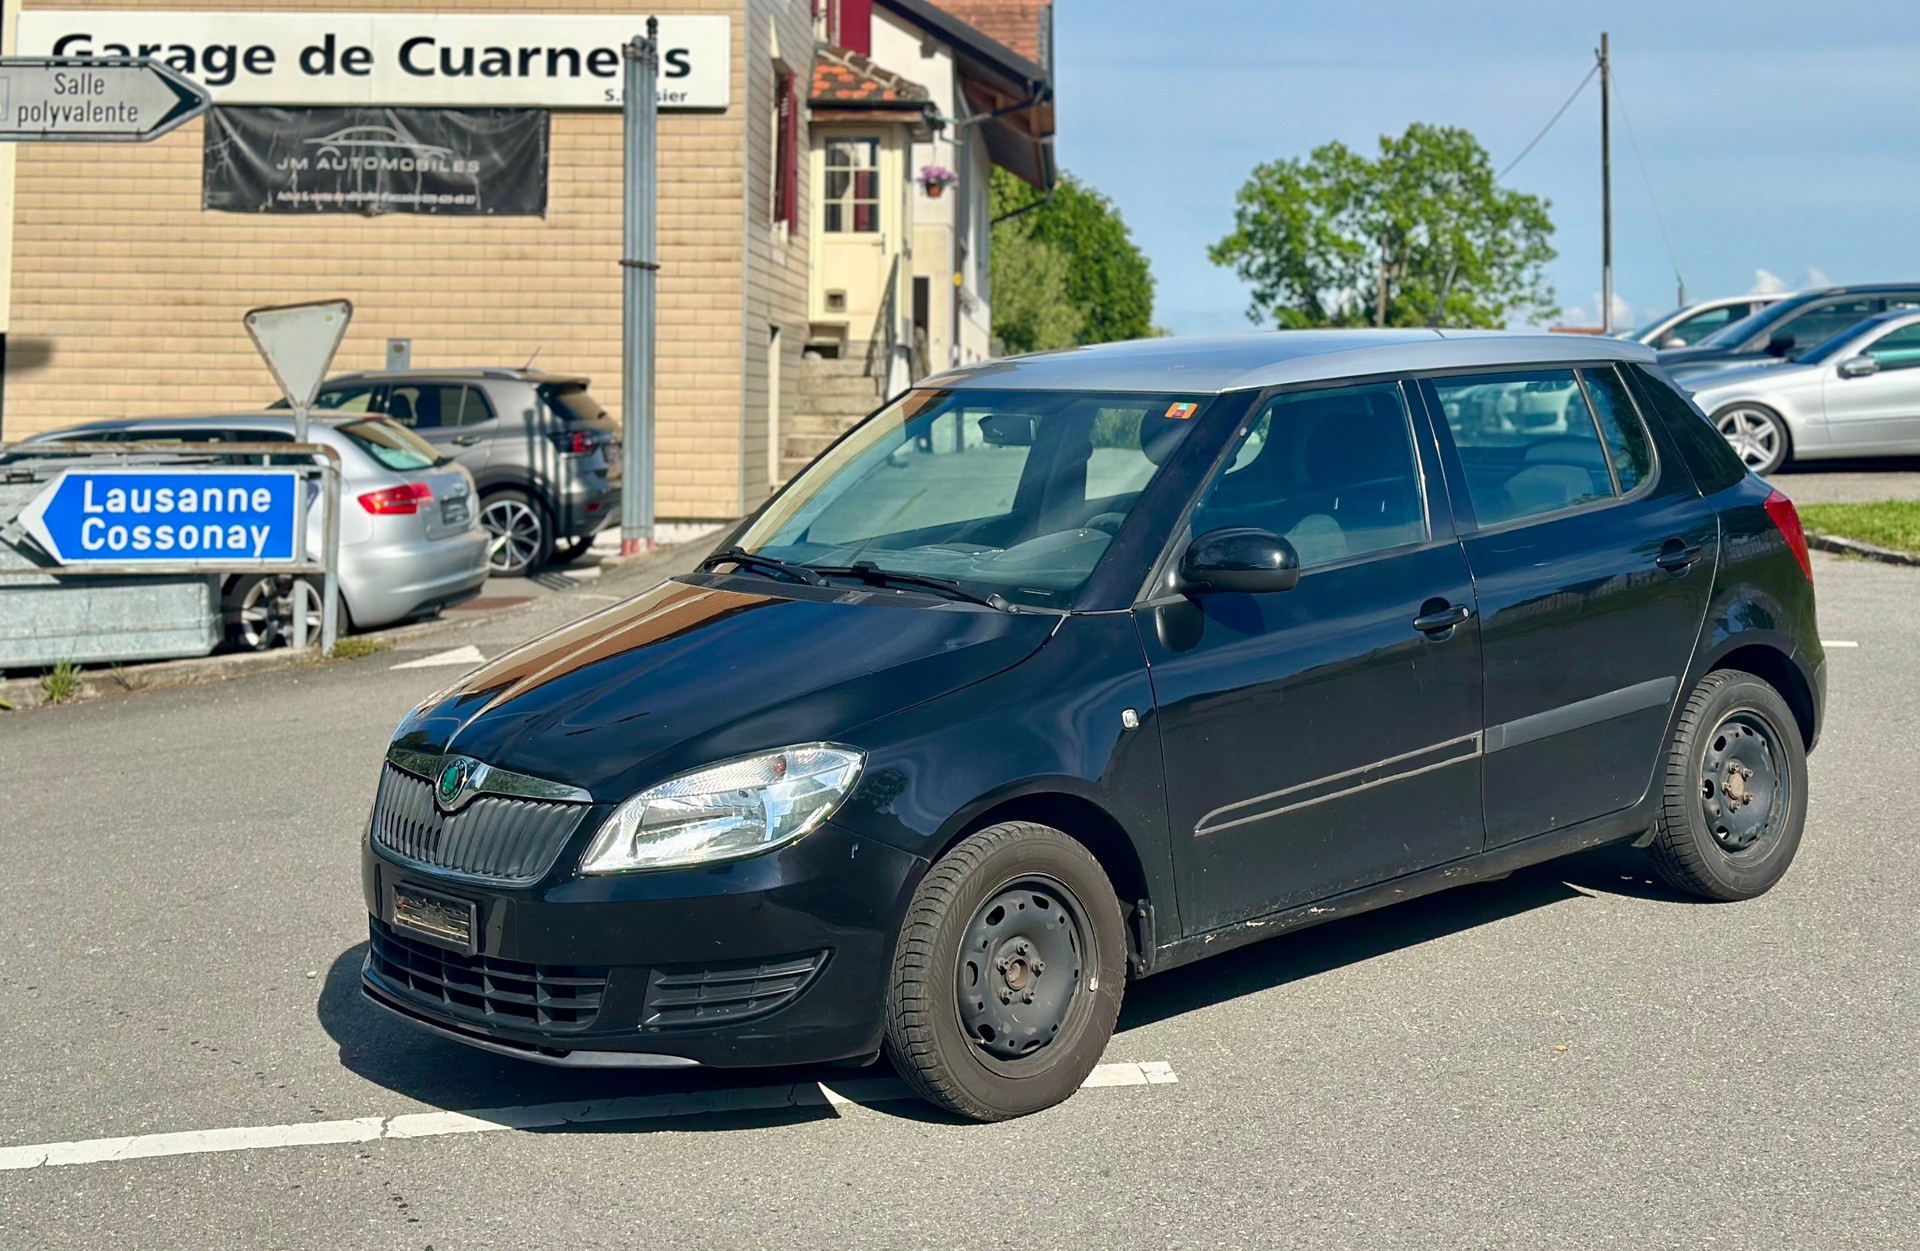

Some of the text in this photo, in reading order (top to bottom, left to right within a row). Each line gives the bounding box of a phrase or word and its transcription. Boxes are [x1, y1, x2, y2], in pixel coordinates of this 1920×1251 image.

[298, 33, 374, 76] de
[398, 36, 692, 78] Cuarnes
[53, 72, 105, 95] Salle
[17, 100, 139, 128] polyvalente
[276, 157, 480, 173] JM AUTOMOBILES
[83, 479, 272, 514] Lausanne
[81, 516, 271, 557] Cossonay
